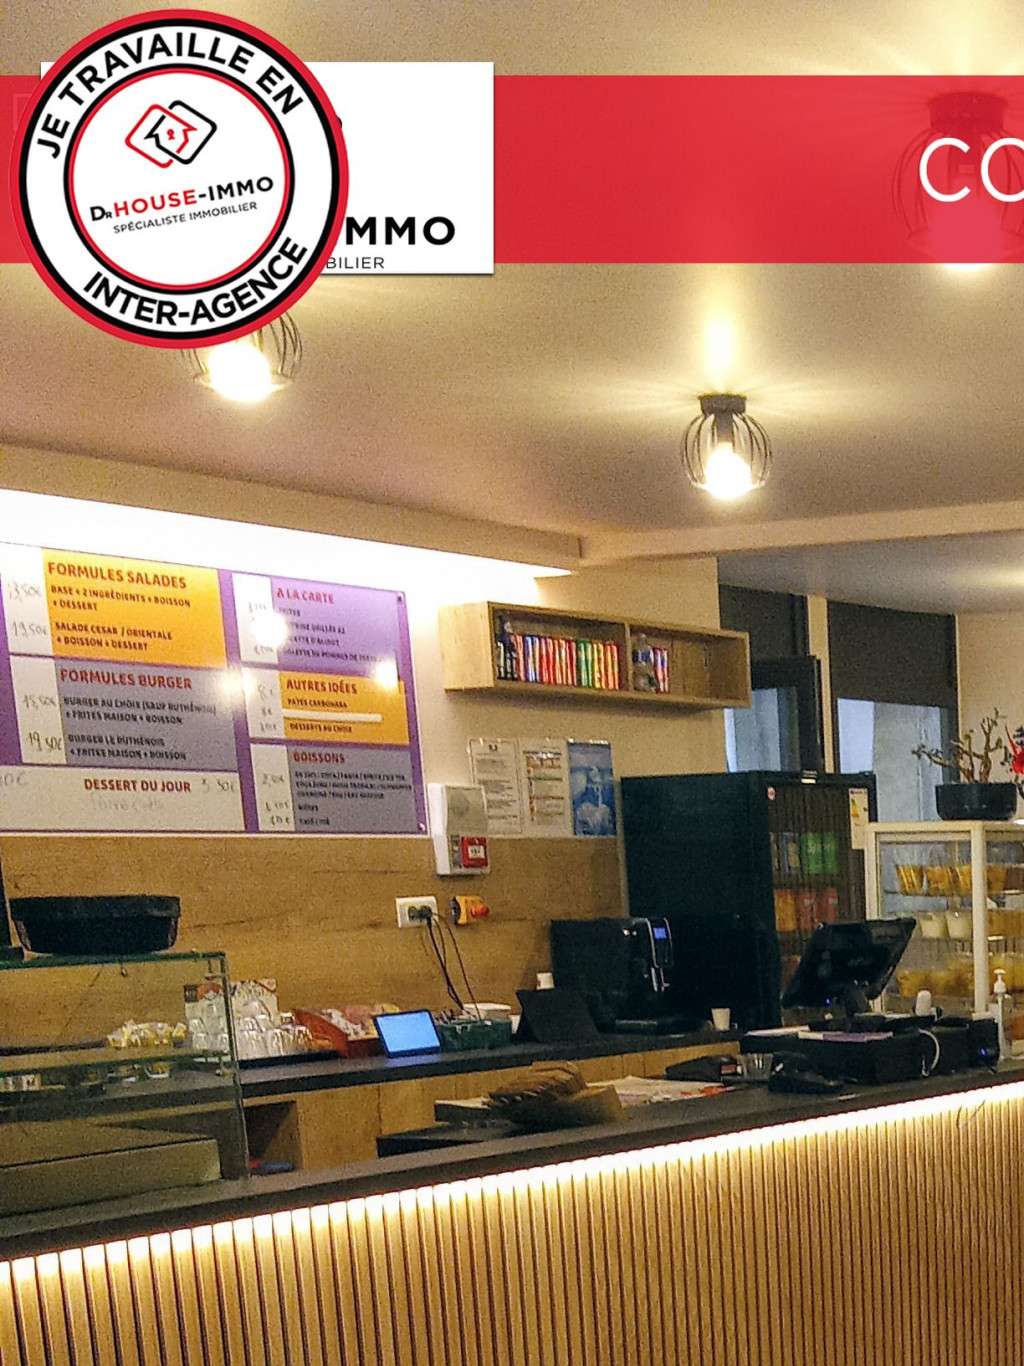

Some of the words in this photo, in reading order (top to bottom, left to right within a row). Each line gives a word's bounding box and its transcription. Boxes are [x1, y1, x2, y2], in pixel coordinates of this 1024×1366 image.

[48, 562, 124, 582] FORMULES
[127, 571, 187, 589] SALADES
[51, 585, 73, 595] BASE
[89, 588, 145, 603] INGRÉDIENTS
[154, 596, 191, 608] BOISSON
[301, 591, 334, 604] CARTE
[60, 600, 98, 611] DESSERT
[55, 622, 89, 633] SALADE
[126, 628, 173, 641] ORIENTALE
[64, 637, 103, 648] BOISSON
[112, 641, 148, 651] DESSERT
[60, 668, 136, 686] FORMULES
[139, 675, 193, 690] BURGER
[286, 679, 326, 692] AUTRES
[329, 680, 357, 695] IDÉES
[63, 696, 99, 707] BURGER
[101, 698, 113, 708] AU
[115, 699, 141, 709] CHOIX
[72, 711, 102, 721] FRITES
[104, 712, 138, 722] MAISON
[146, 714, 184, 725] BOISSON
[68, 734, 104, 745] BURGER
[108, 749, 142, 760] MAISON
[150, 751, 187, 761] BOISSON
[293, 752, 345, 764] BOISSONS
[84, 778, 137, 792] DESSERT
[140, 780, 158, 792] DU
[160, 780, 191, 793] JOUR
